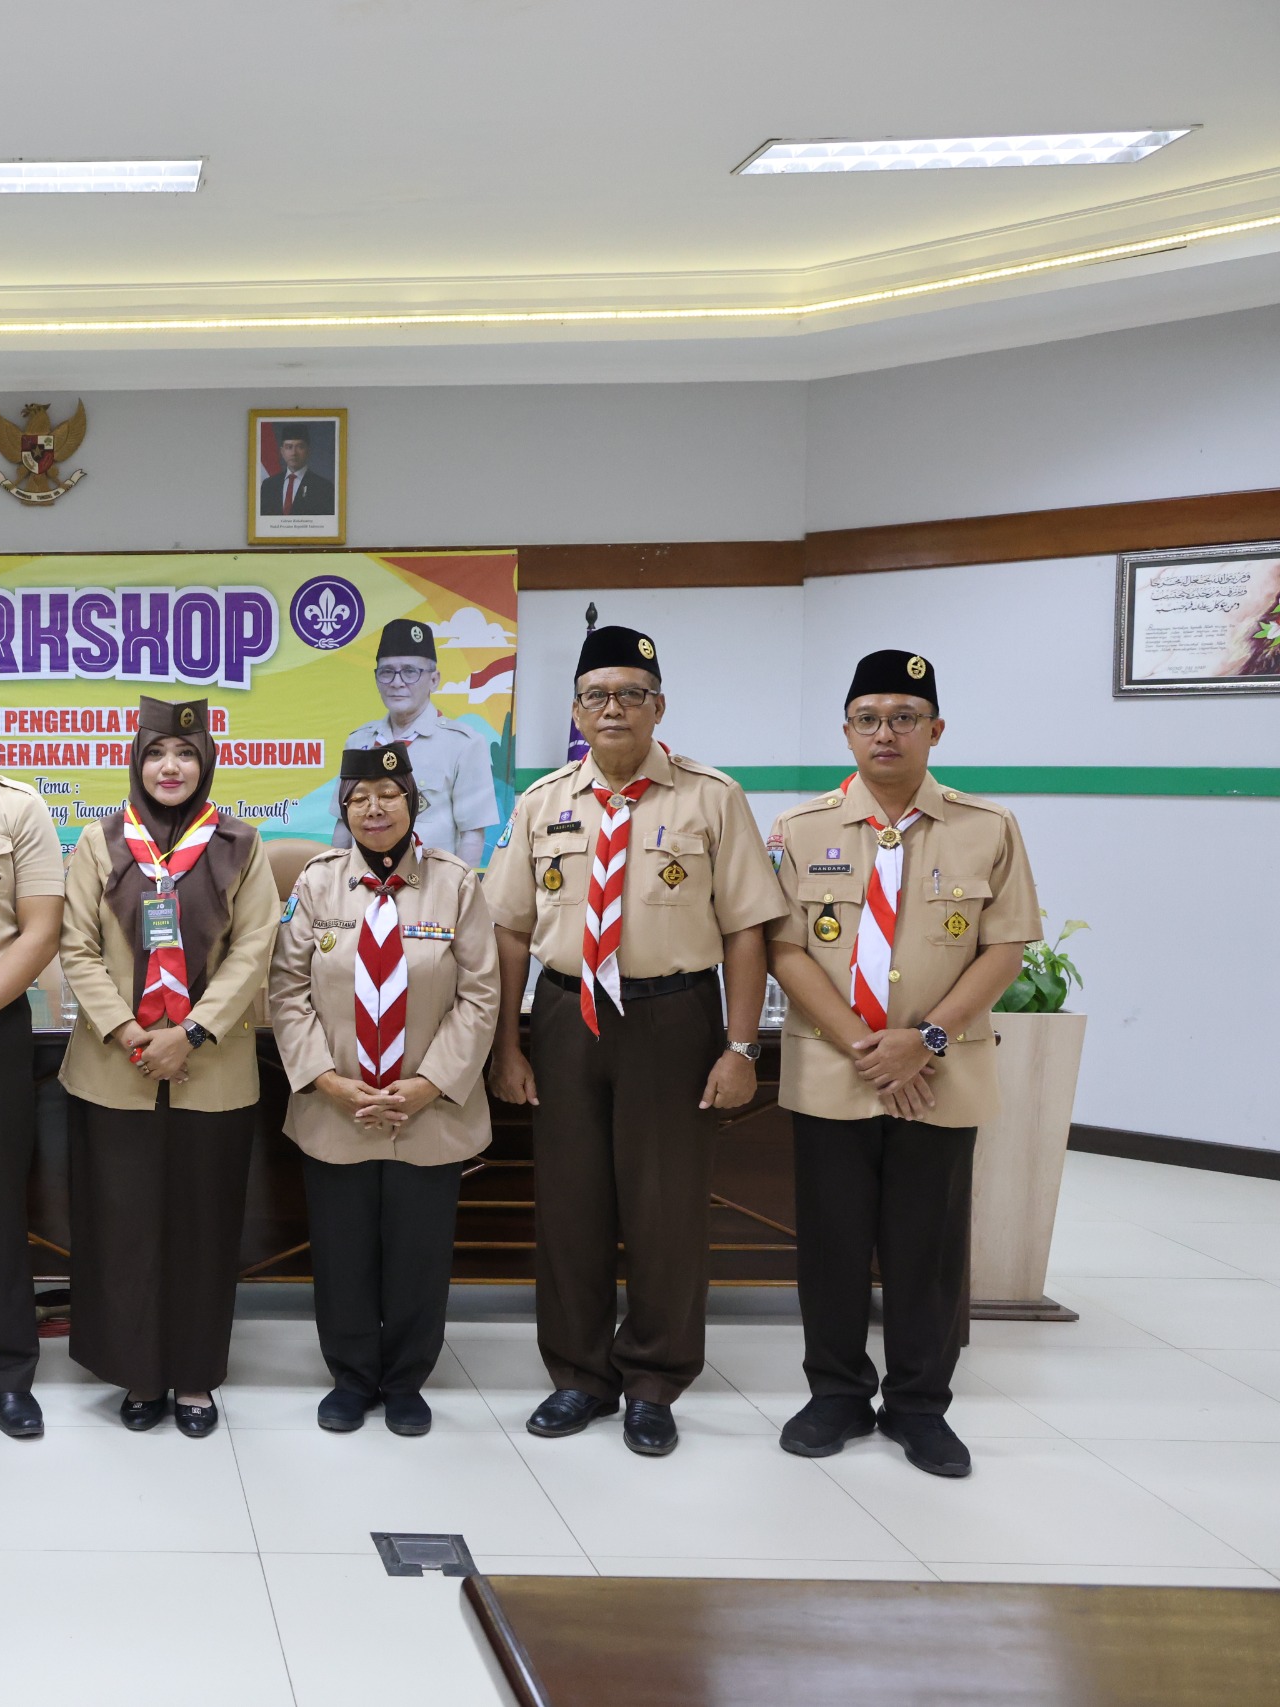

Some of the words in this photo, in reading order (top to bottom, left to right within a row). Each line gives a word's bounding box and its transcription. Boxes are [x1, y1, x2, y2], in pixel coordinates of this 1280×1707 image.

[5, 709, 121, 733] PENGELOLA
[35, 777, 71, 794] Tema
[237, 799, 289, 824] Inovatif
